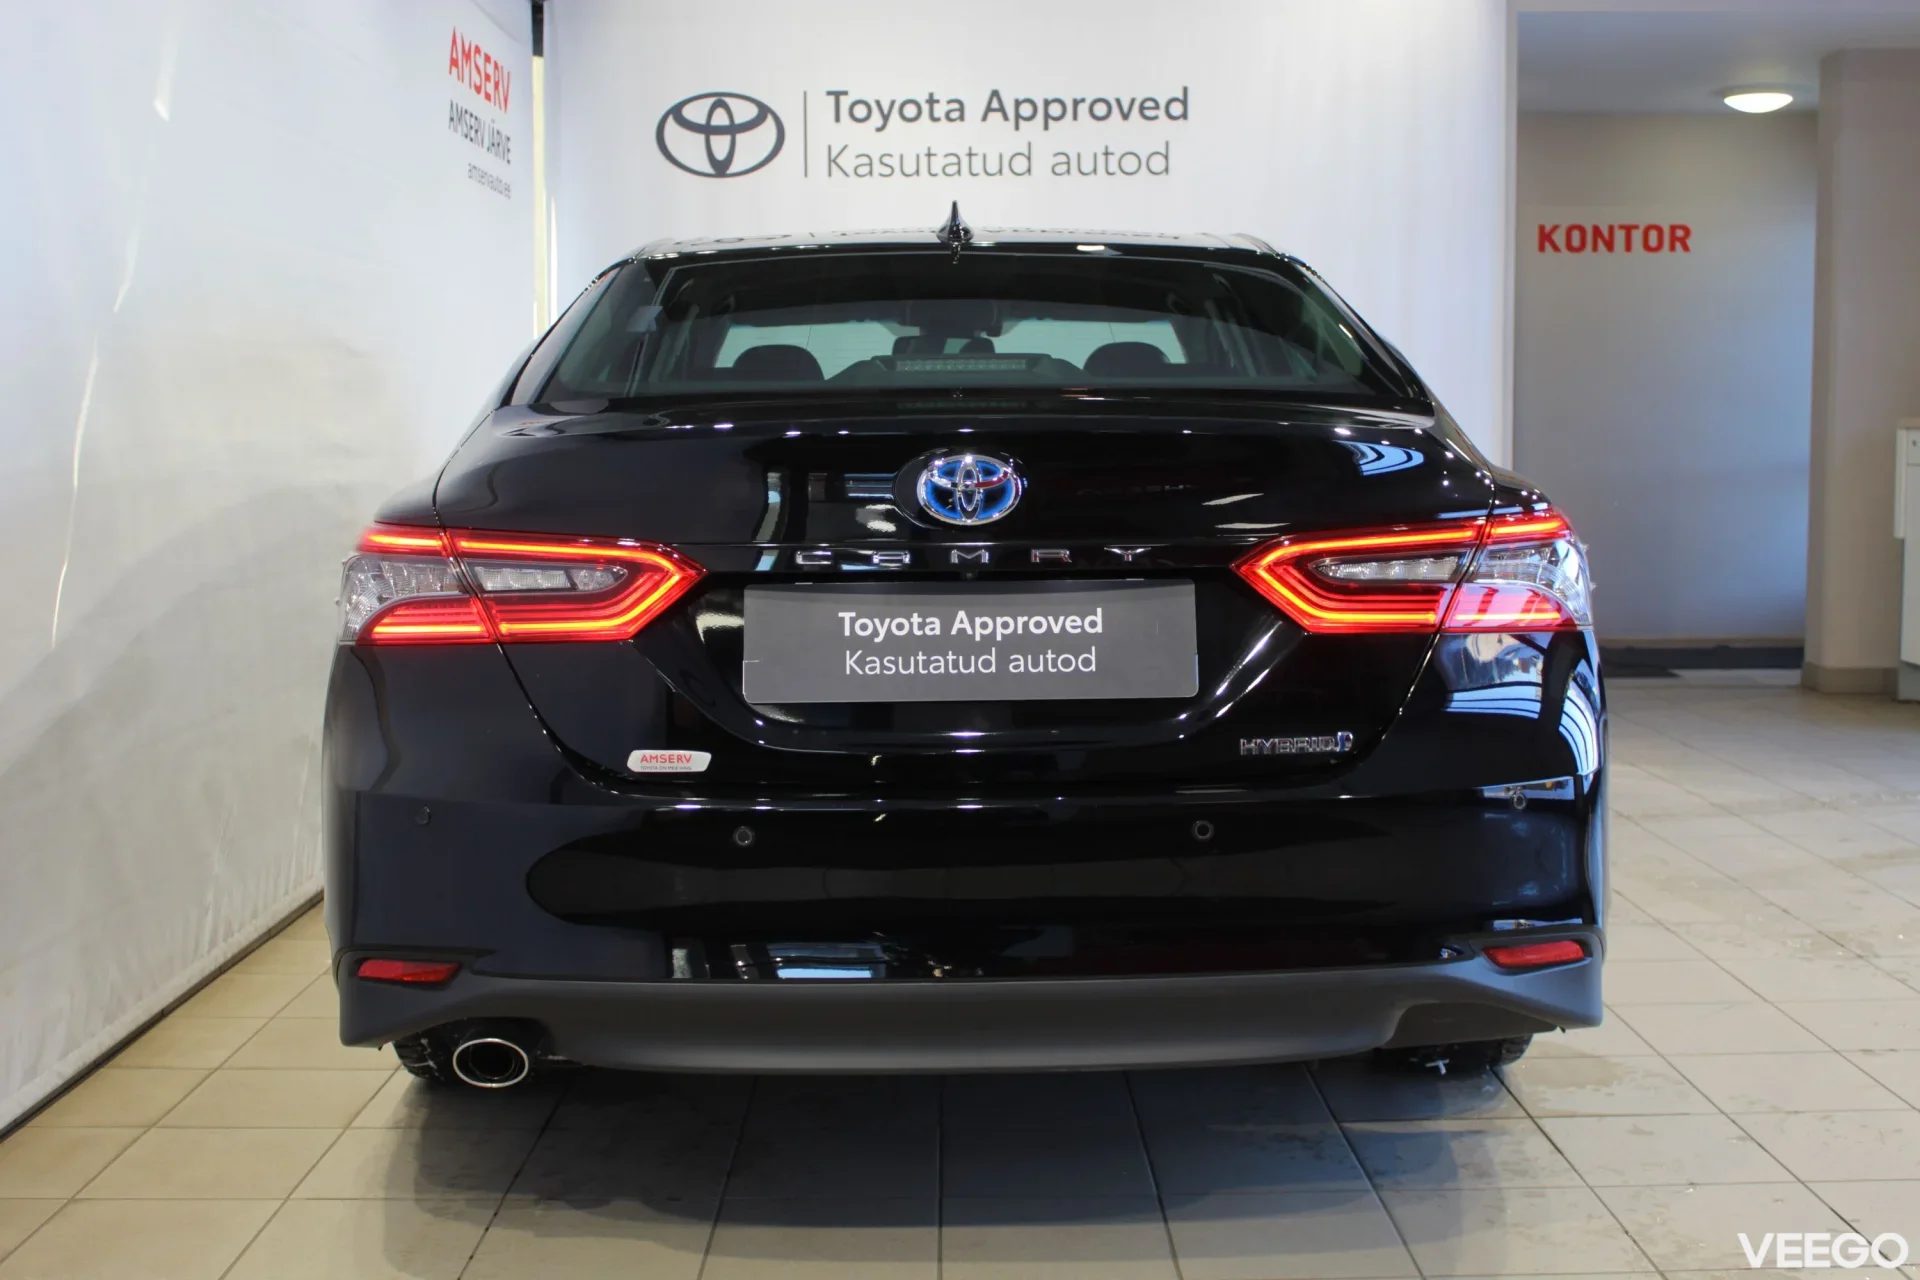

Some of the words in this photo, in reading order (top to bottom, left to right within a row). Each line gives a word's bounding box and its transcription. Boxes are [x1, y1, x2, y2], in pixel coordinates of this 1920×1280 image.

[449, 26, 511, 114] AMSERV
[448, 99, 486, 149] AMSERV
[826, 90, 967, 132] Toyota
[981, 87, 1190, 131] Approved
[827, 142, 1033, 178] Kasutatud
[1051, 141, 1171, 177] autod
[1537, 223, 1692, 253] KONTOR
[796, 547, 1152, 564] CAMRY
[838, 611, 942, 643] Toyota
[950, 607, 1103, 641] Approved
[845, 647, 996, 676] Kasutatud
[1008, 646, 1097, 673] autod
[640, 753, 692, 764] AMSERV
[1240, 737, 1337, 755] HYBRID
